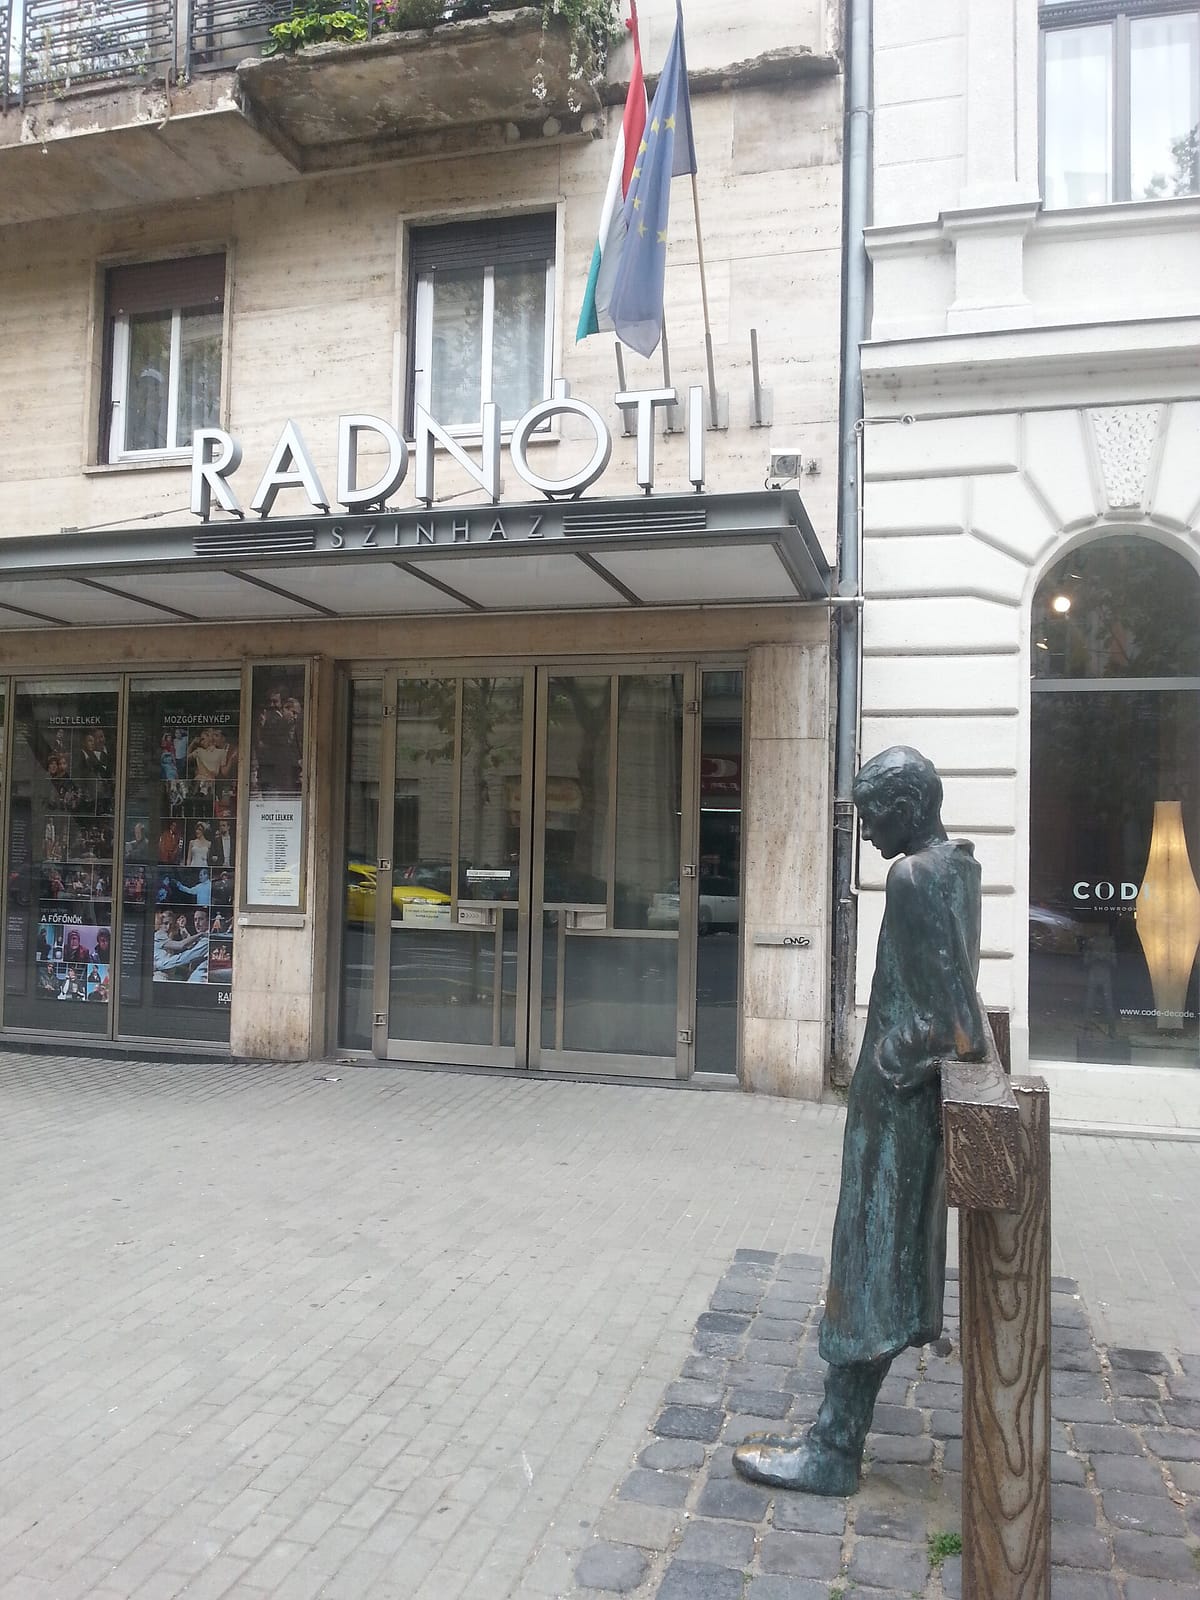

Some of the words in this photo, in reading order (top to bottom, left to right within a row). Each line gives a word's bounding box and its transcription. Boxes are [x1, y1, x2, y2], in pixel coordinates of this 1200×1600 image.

[190, 378, 707, 520] RADNÓTI
[49, 716, 70, 725] HOLT
[71, 716, 101, 725] LELKEK
[261, 813, 274, 821] HOLT
[275, 813, 294, 821] LELKEK
[40, 914, 47, 922] A
